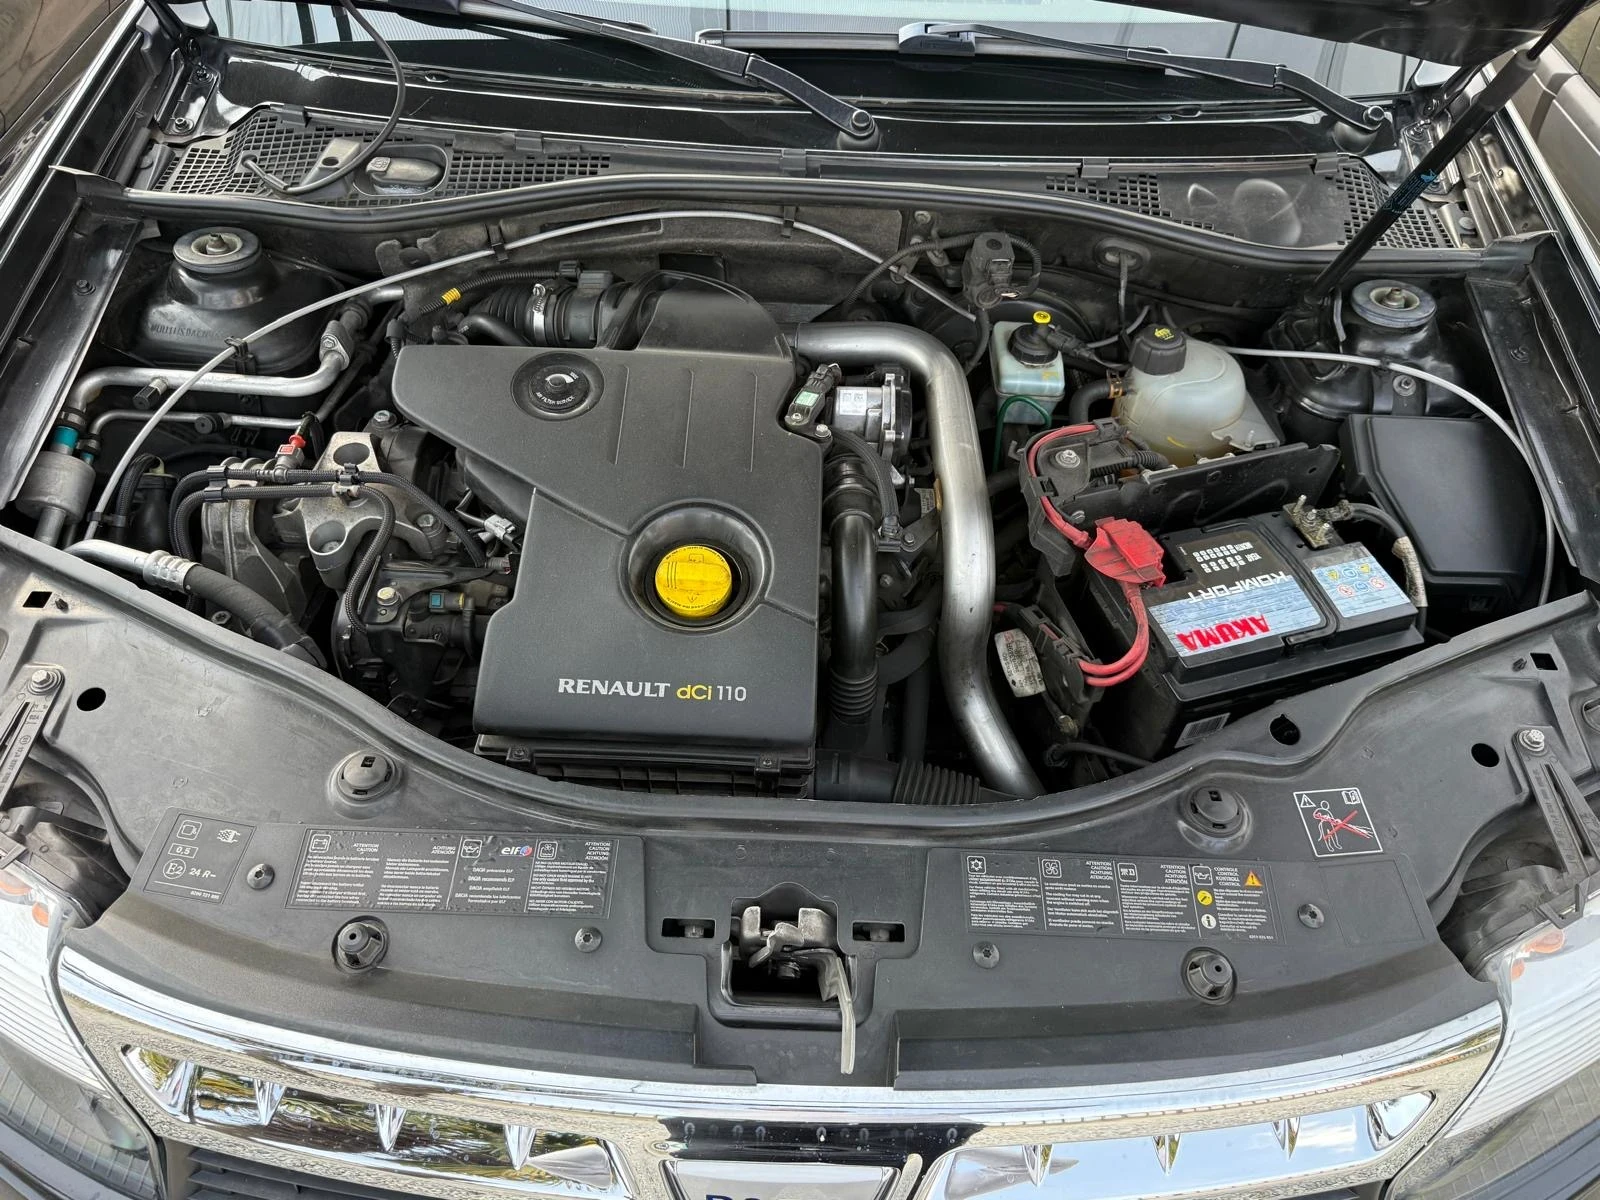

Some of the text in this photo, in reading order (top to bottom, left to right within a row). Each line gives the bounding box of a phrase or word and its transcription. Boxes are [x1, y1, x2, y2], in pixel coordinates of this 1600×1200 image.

[1187, 571, 1293, 603] KOMFORT
[1175, 613, 1271, 651] AKUMA
[558, 678, 747, 701] RENAULT dCi 110
[501, 846, 520, 855] elf
[189, 868, 200, 876] 24
